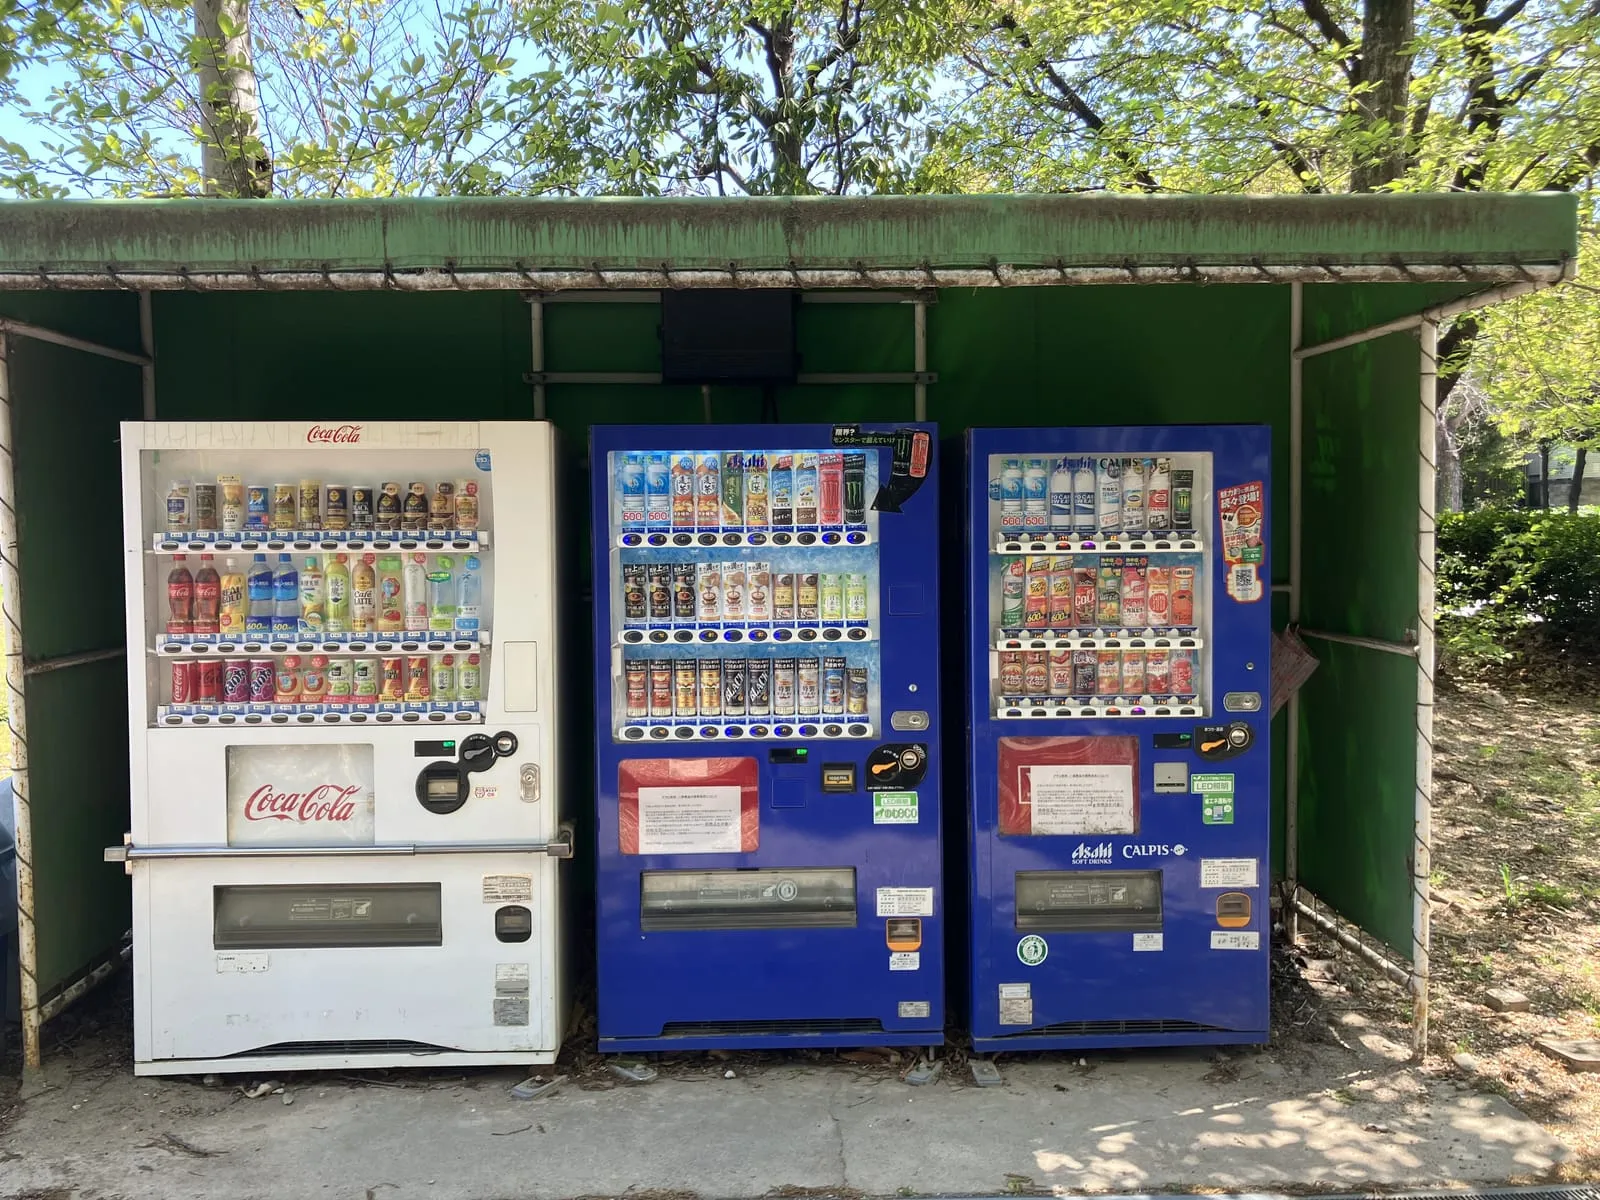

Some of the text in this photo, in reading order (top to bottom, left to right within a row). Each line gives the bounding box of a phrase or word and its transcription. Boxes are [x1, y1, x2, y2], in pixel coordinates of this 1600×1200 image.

[307, 425, 363, 443] Coca-Cola
[1002, 516, 1021, 526] 600
[244, 784, 362, 822] Coca-Cola
[1072, 842, 1169, 859] Asahi CALPIS
